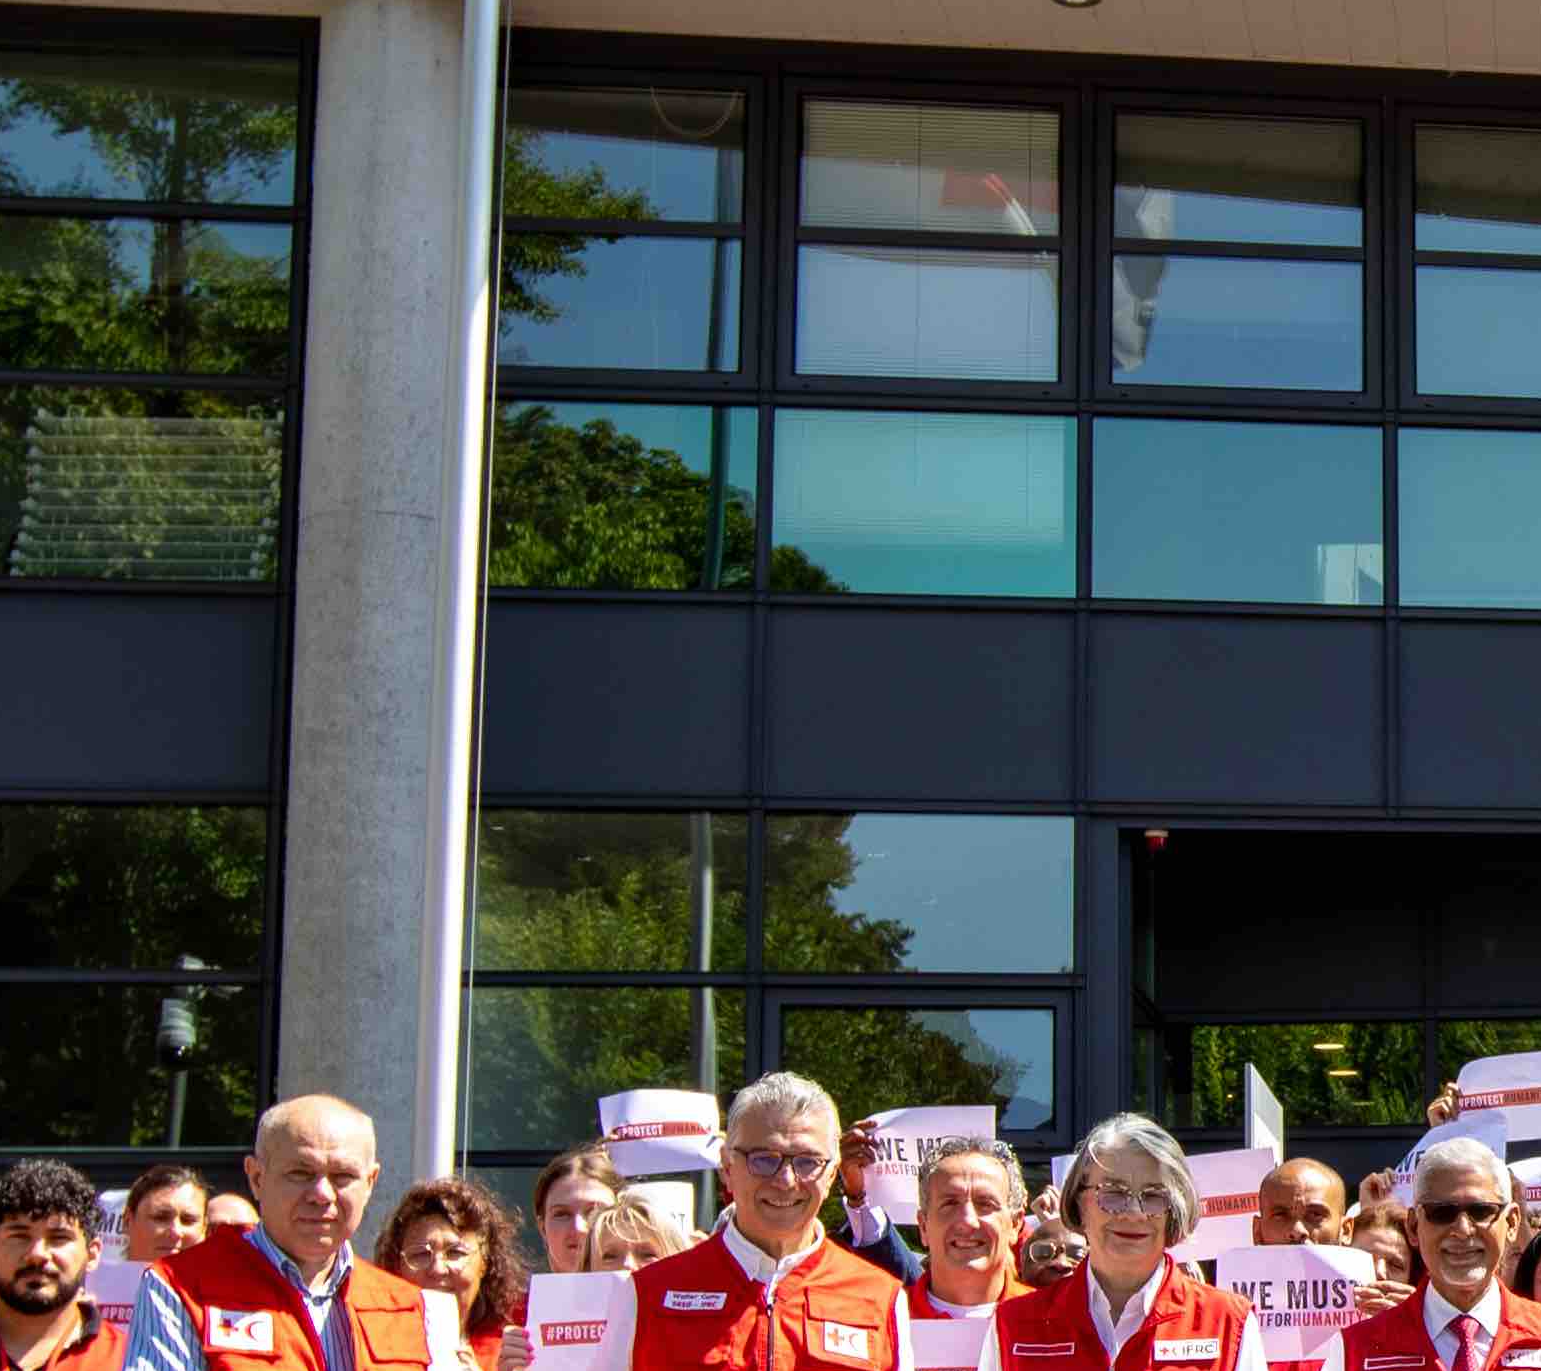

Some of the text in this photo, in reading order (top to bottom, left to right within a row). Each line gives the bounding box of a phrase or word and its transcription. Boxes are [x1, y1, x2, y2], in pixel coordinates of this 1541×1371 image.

[1233, 1281, 1274, 1310] WE
[1258, 1310, 1362, 1328] TFORHUMANITY
[1181, 1342, 1215, 1355] IFRC
